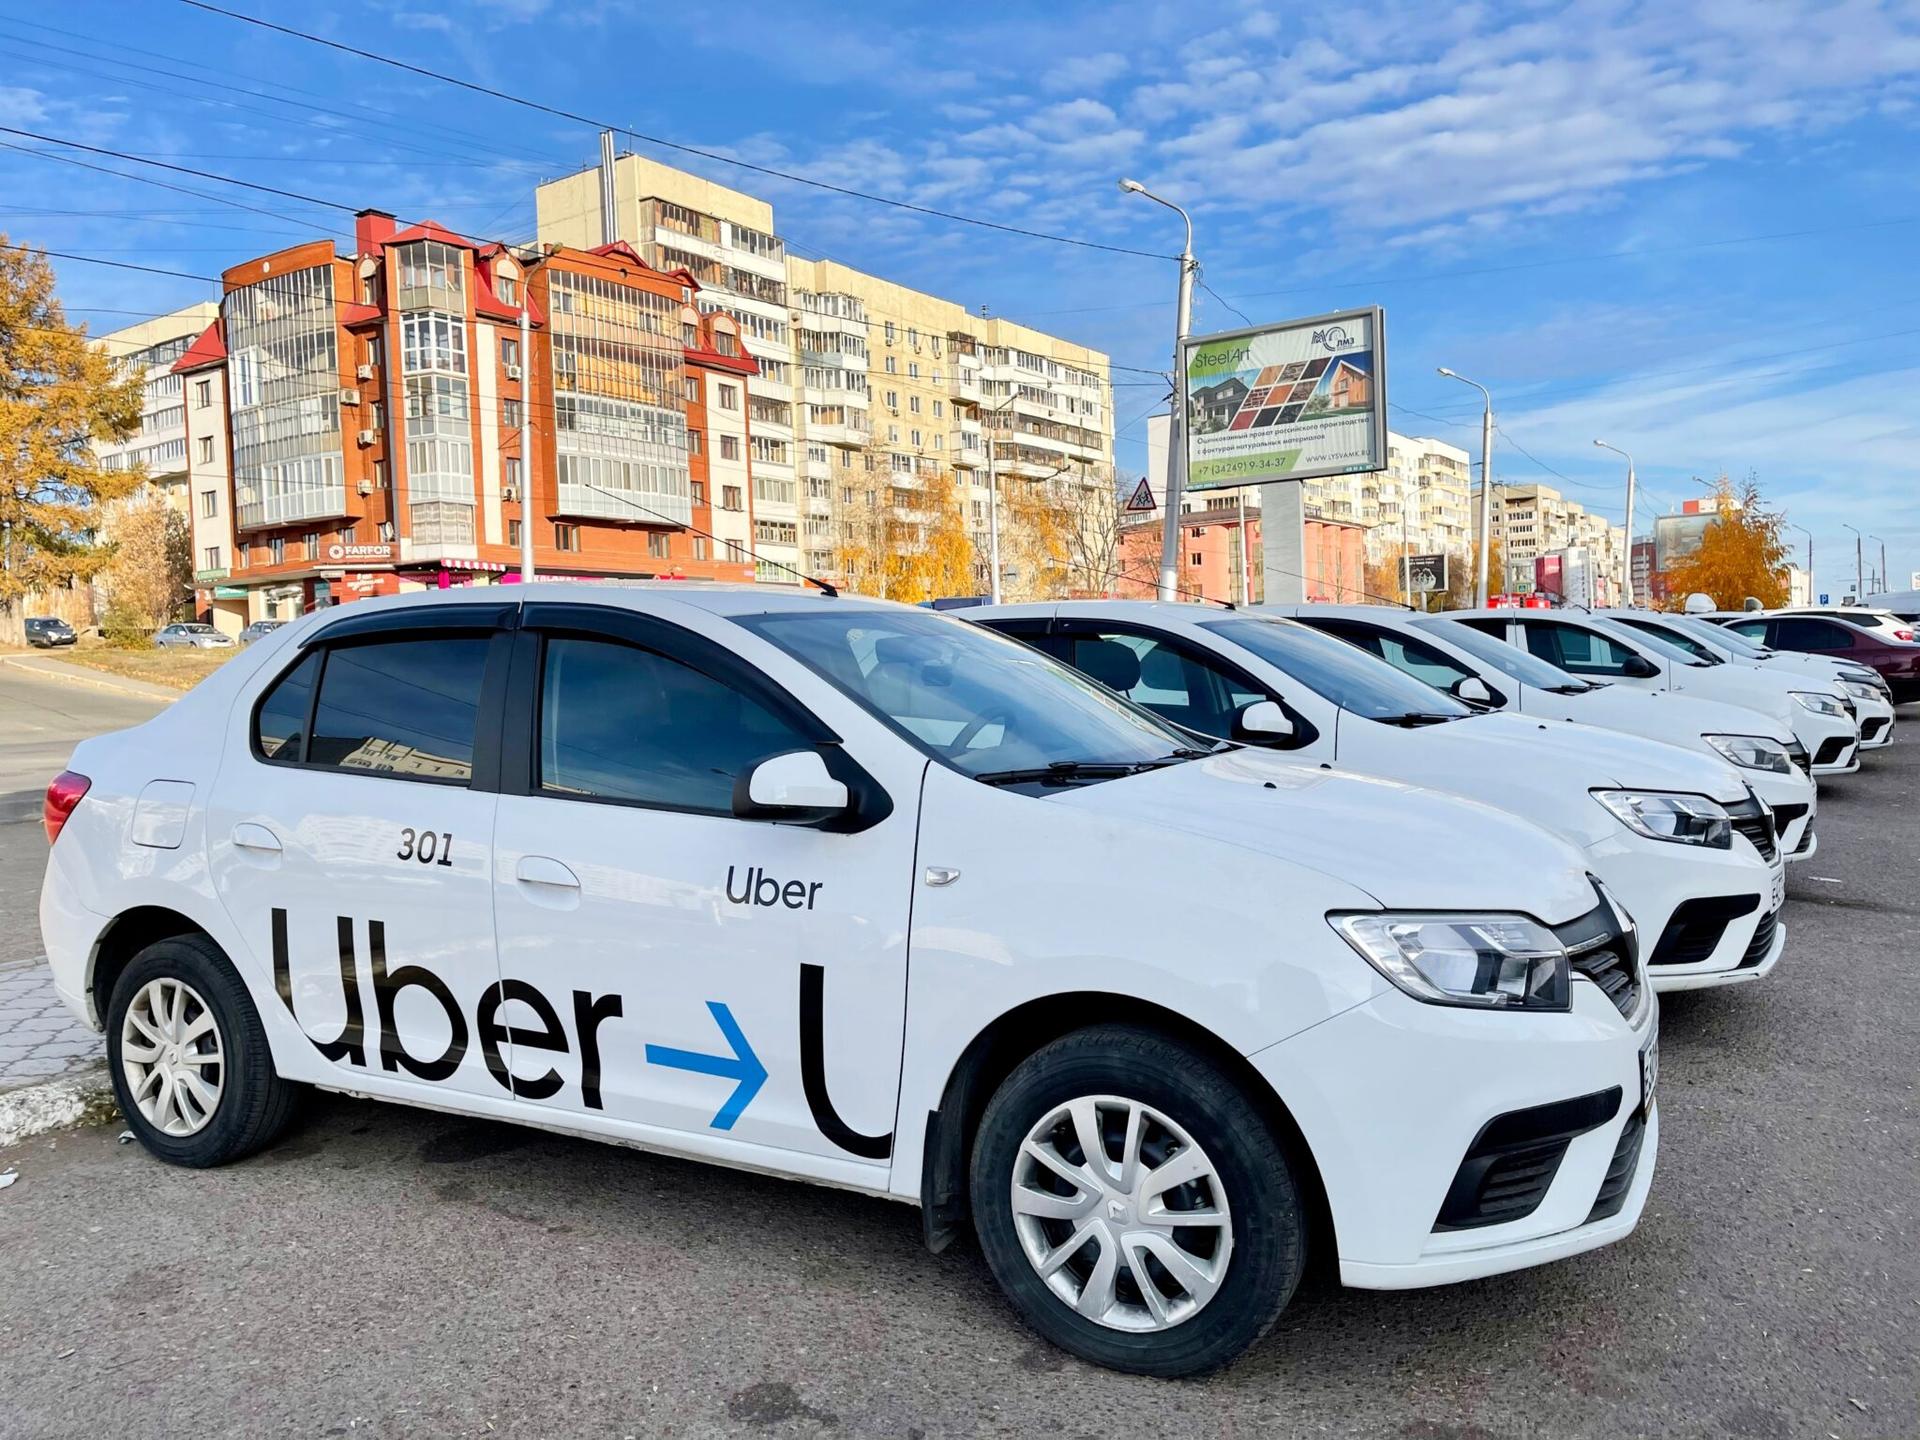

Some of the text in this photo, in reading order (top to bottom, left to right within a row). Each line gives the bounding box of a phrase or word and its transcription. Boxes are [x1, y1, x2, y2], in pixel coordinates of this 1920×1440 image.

[1249, 430, 1273, 440] прокат
[1274, 424, 1318, 436] российского
[1236, 440, 1282, 452] натуральных
[1283, 434, 1325, 445] материалов
[1211, 461, 1247, 476] (34249)
[1249, 456, 1286, 469] 9-34-37
[345, 545, 391, 555] FARFOR
[396, 827, 453, 867] 301
[725, 864, 823, 910] Uber
[270, 907, 623, 1111] Uber
